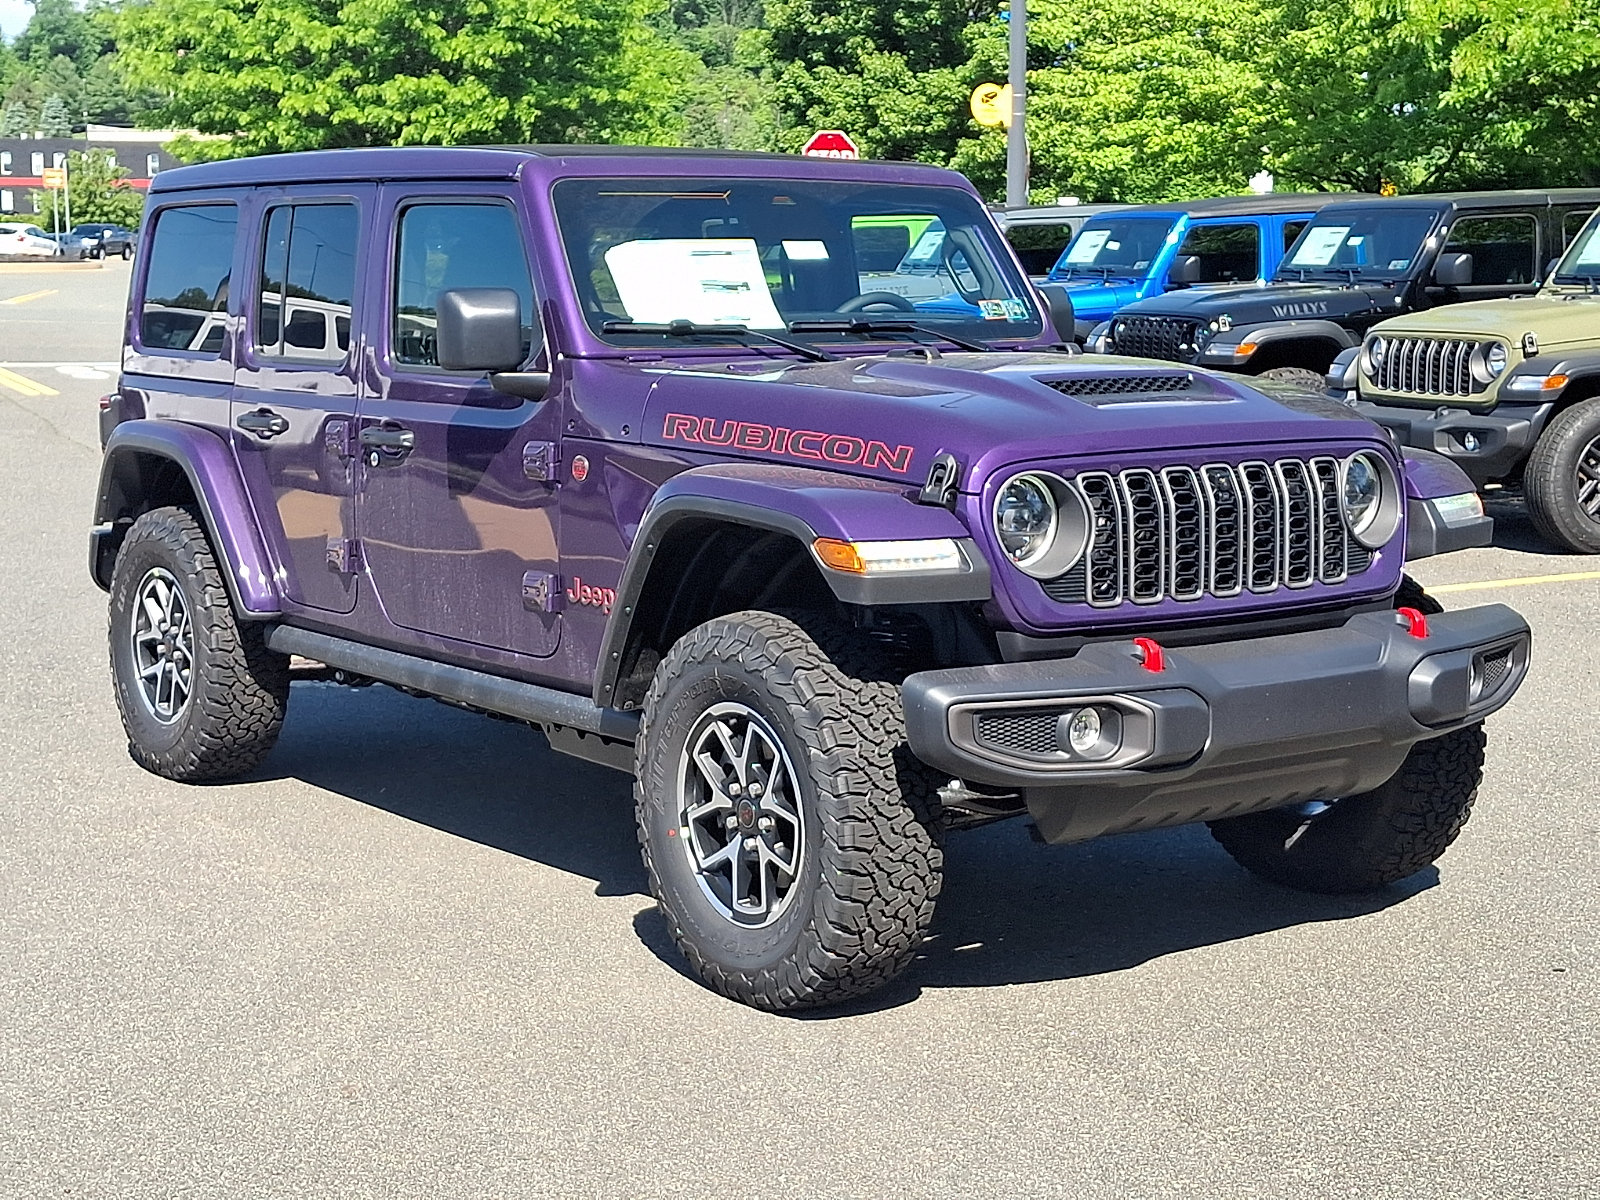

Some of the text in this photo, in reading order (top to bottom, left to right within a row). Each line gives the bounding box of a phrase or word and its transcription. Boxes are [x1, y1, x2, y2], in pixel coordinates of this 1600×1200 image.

[1271, 301, 1328, 318] WILLYS
[663, 413, 914, 473] RUBICON
[567, 576, 616, 615] Jeep
